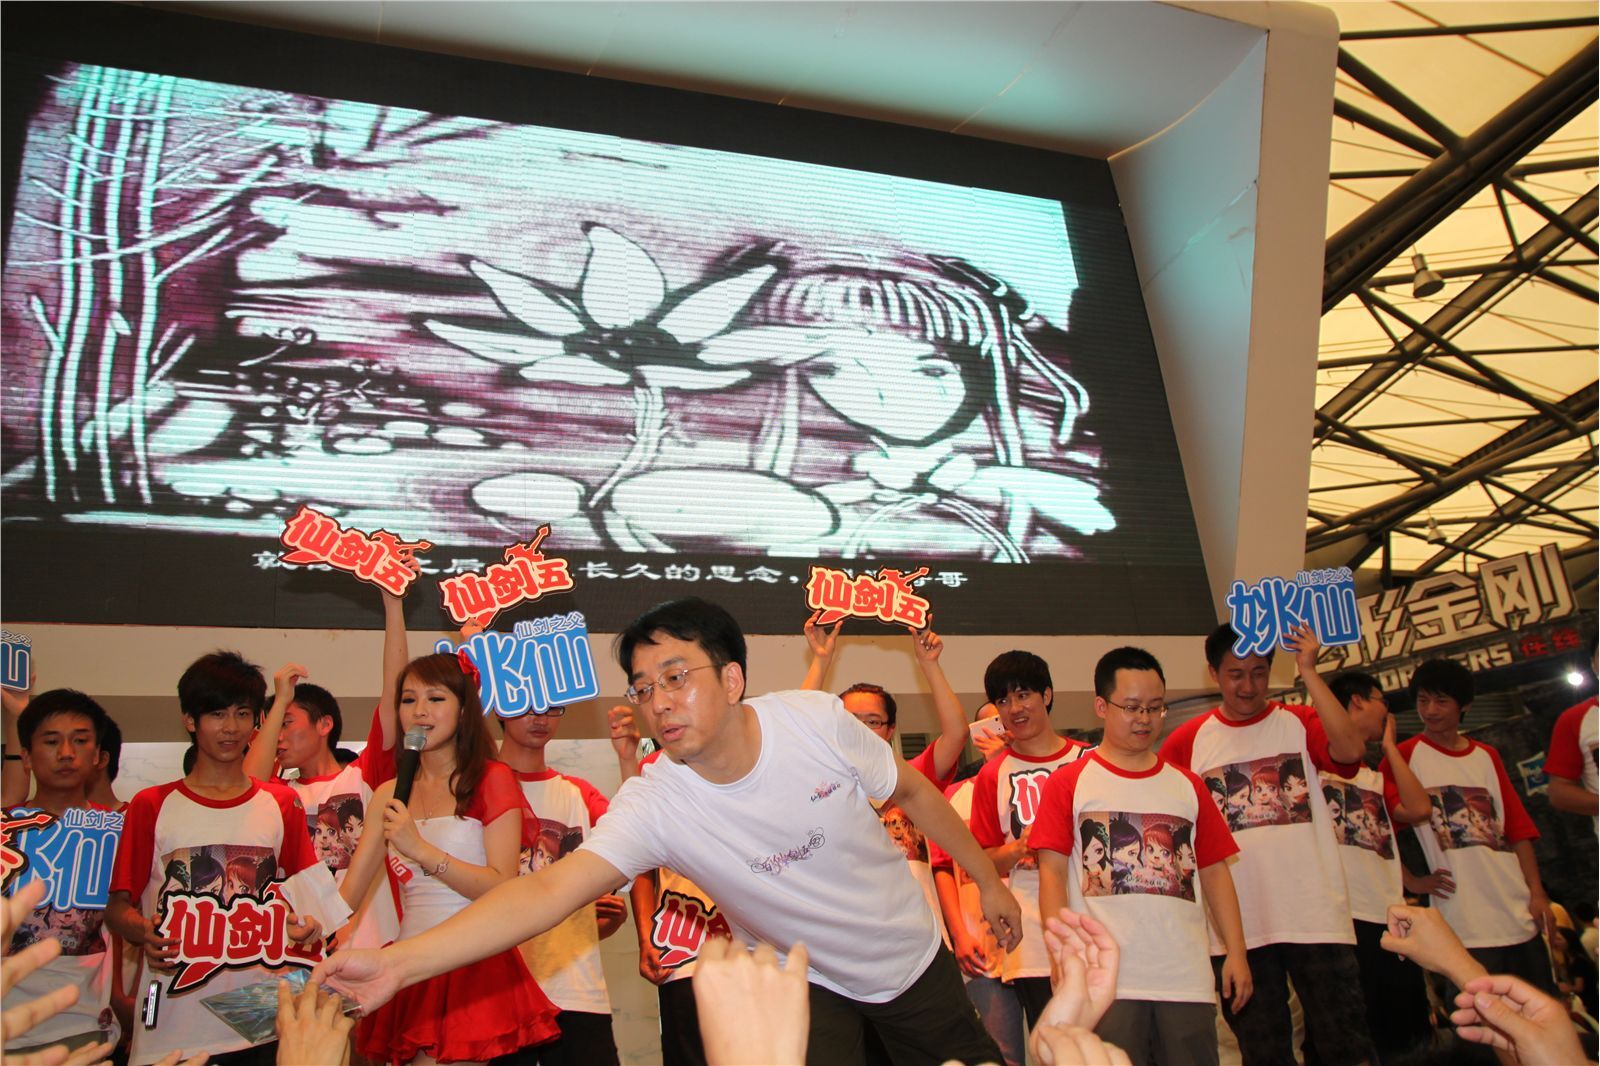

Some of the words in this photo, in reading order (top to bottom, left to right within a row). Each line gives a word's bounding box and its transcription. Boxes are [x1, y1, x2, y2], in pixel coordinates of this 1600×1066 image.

[281, 506, 418, 596] 仙剑五
[1296, 567, 1353, 587] 仙剑之父
[441, 555, 577, 623] 仙剑五
[805, 566, 930, 629] 仙剑五
[1226, 577, 1362, 658] 姚仙
[1313, 541, 1577, 674] 形金刚
[513, 611, 586, 640] 仙剑之父
